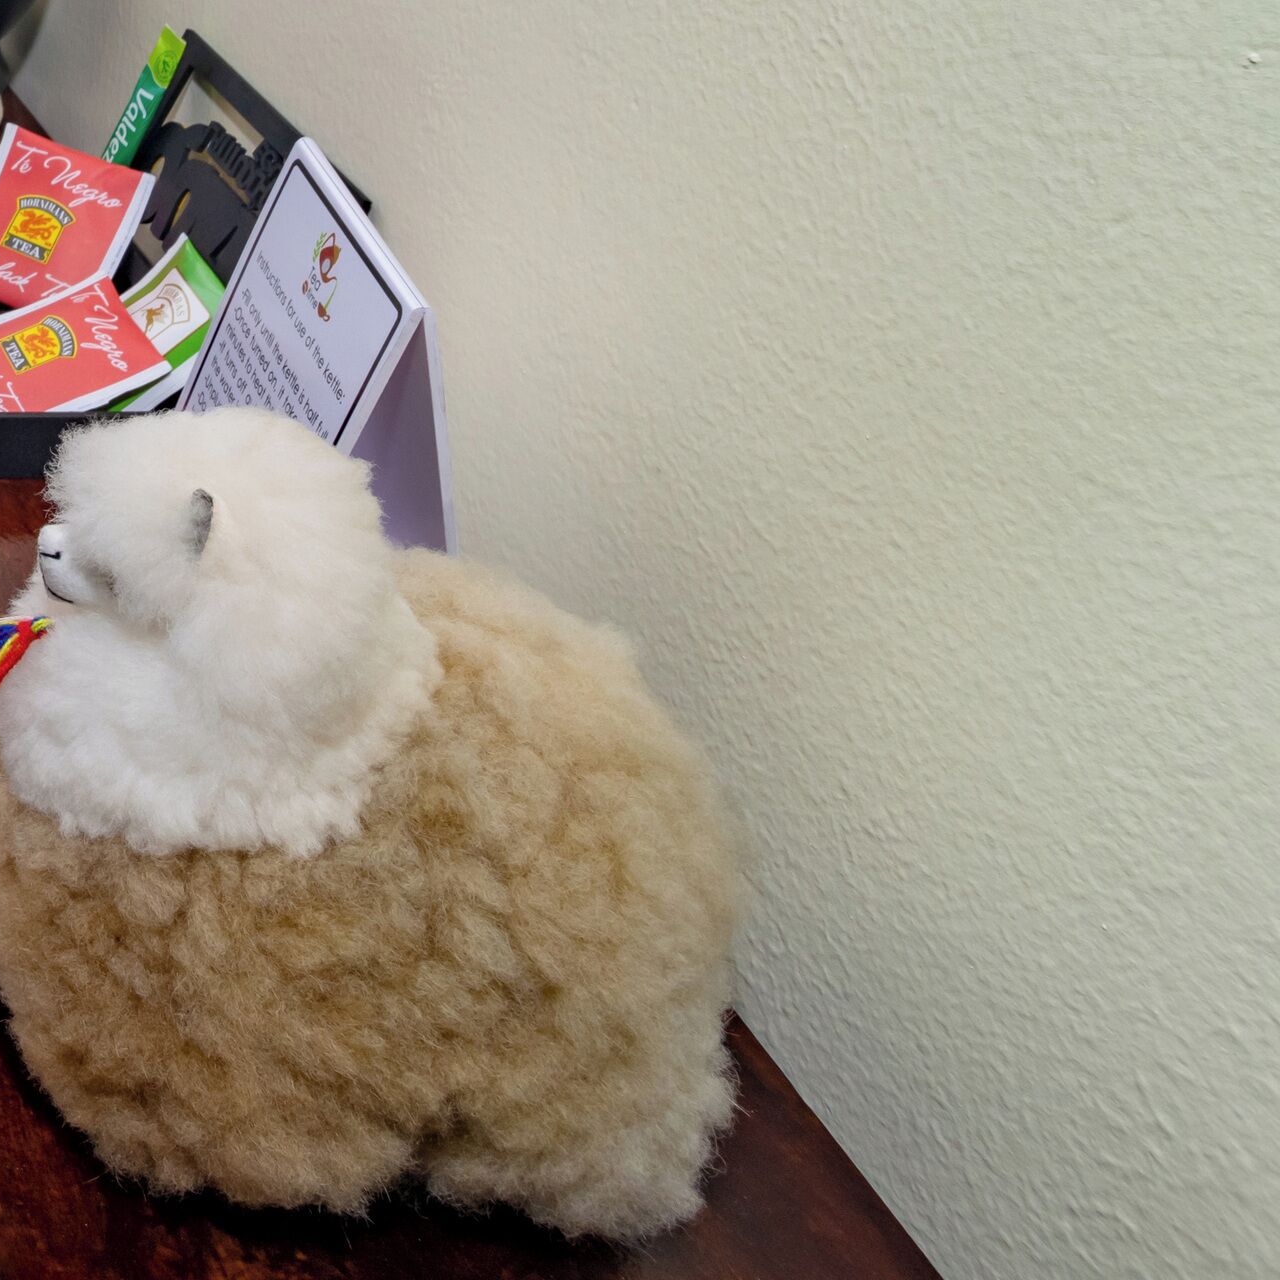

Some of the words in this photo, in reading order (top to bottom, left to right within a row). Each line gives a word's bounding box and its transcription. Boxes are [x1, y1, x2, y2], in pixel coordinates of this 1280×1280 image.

[103, 87, 154, 163] Valdez
[44, 156, 123, 208] Negro
[20, 198, 73, 225] HORNIMANS
[12, 238, 40, 259] TEA
[309, 266, 321, 291] Tea
[80, 305, 128, 372] Negro
[257, 250, 287, 306] Instructions
[285, 299, 296, 320] for
[294, 317, 307, 338] use
[304, 336, 316, 350] of
[312, 345, 324, 369] the
[323, 363, 345, 404] kettle:
[5, 342, 25, 368] TEA
[211, 354, 220, 377] the
[219, 373, 236, 403] water
[224, 350, 237, 379] turns
[237, 377, 247, 395] off
[226, 323, 246, 362] minutes
[244, 356, 252, 375] to
[250, 369, 267, 399] heat
[249, 304, 261, 328] only
[272, 342, 283, 365] the
[282, 359, 300, 395] kettle
[298, 389, 305, 404] is
[303, 398, 320, 426] half
[250, 334, 270, 372] turned
[268, 371, 278, 392] on,
[277, 385, 286, 401] it
